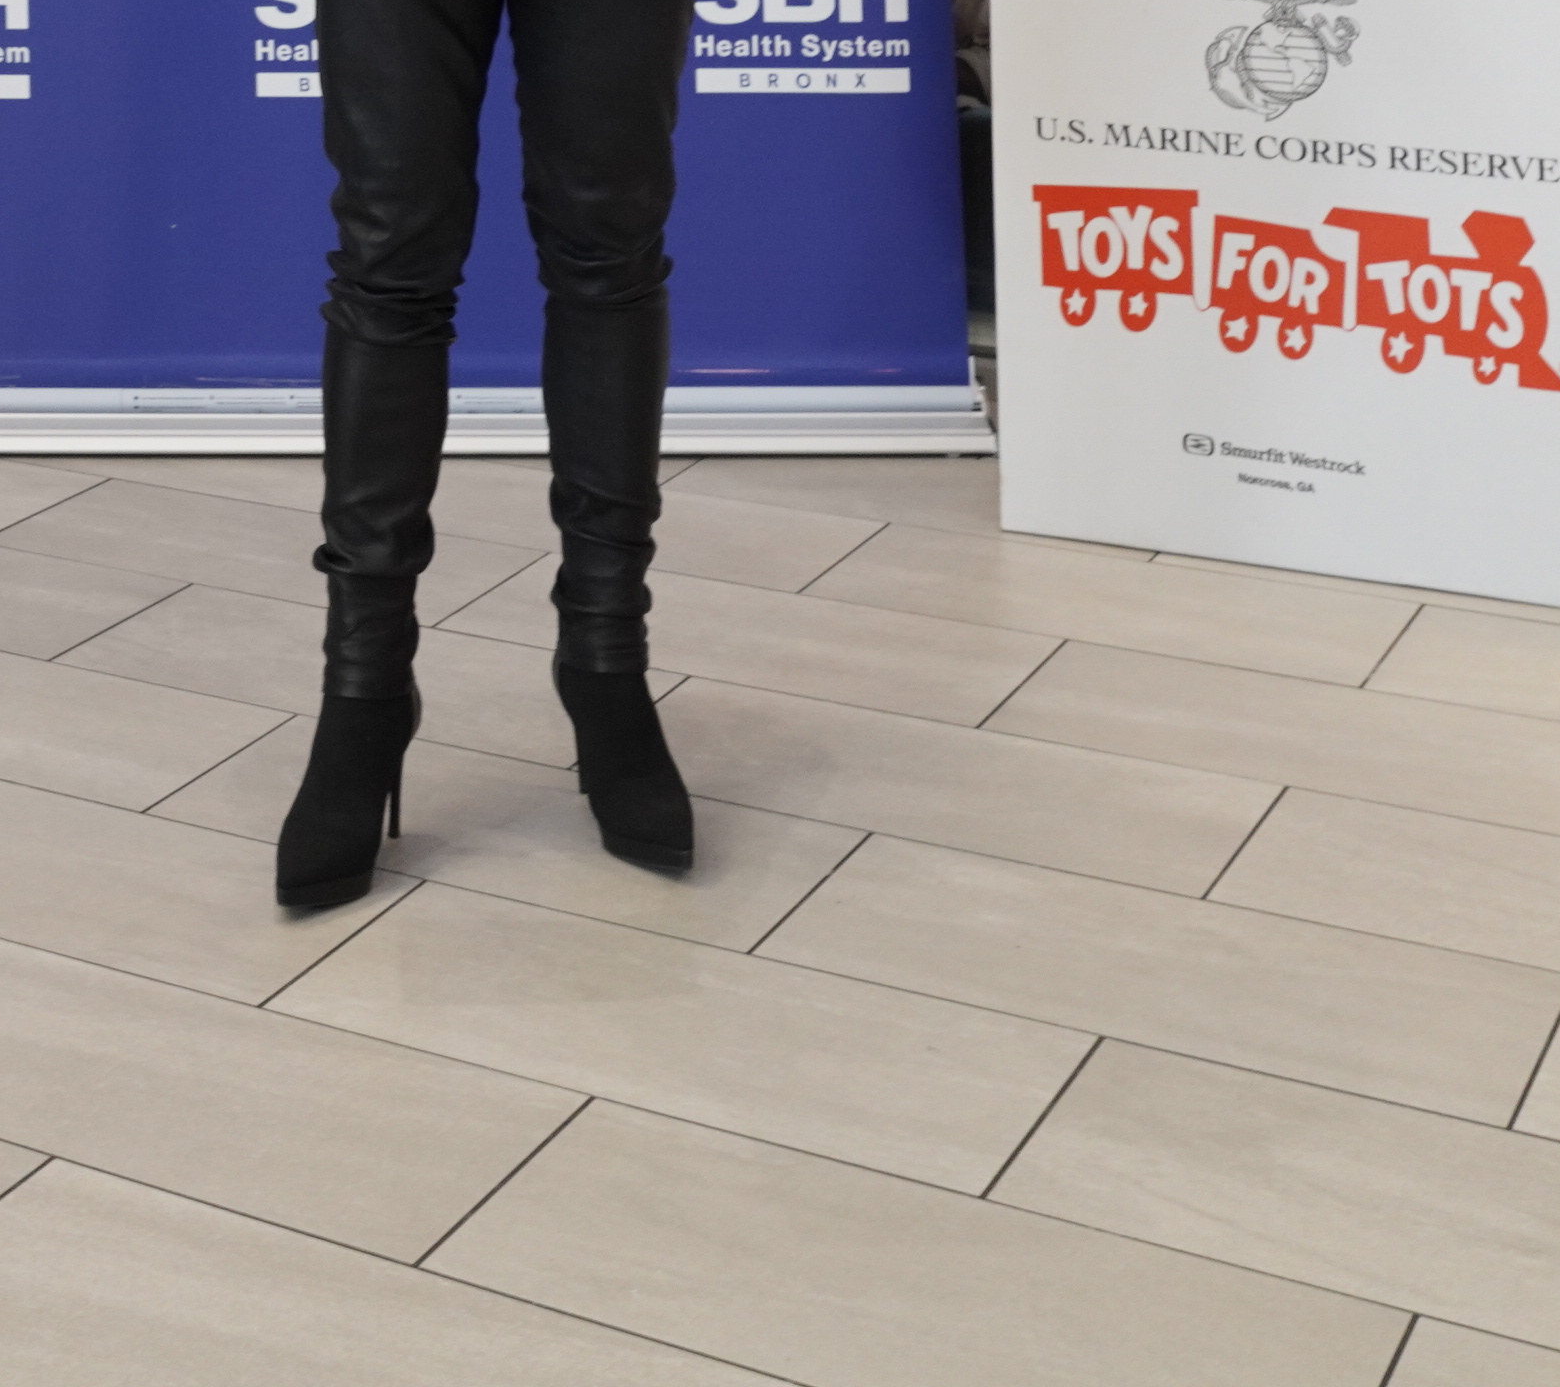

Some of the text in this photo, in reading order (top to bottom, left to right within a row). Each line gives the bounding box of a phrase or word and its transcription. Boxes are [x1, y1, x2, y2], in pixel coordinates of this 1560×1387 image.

[254, 39, 320, 62] Heal
[695, 35, 908, 61] Health System
[738, 72, 866, 90] BRONX
[1034, 115, 1094, 145] U.S.
[1104, 123, 1246, 159] MARINE
[1255, 134, 1377, 169] CORPS
[1047, 204, 1185, 281] TOYS
[1217, 231, 1330, 315] FOR
[1365, 260, 1526, 351] TOTS
